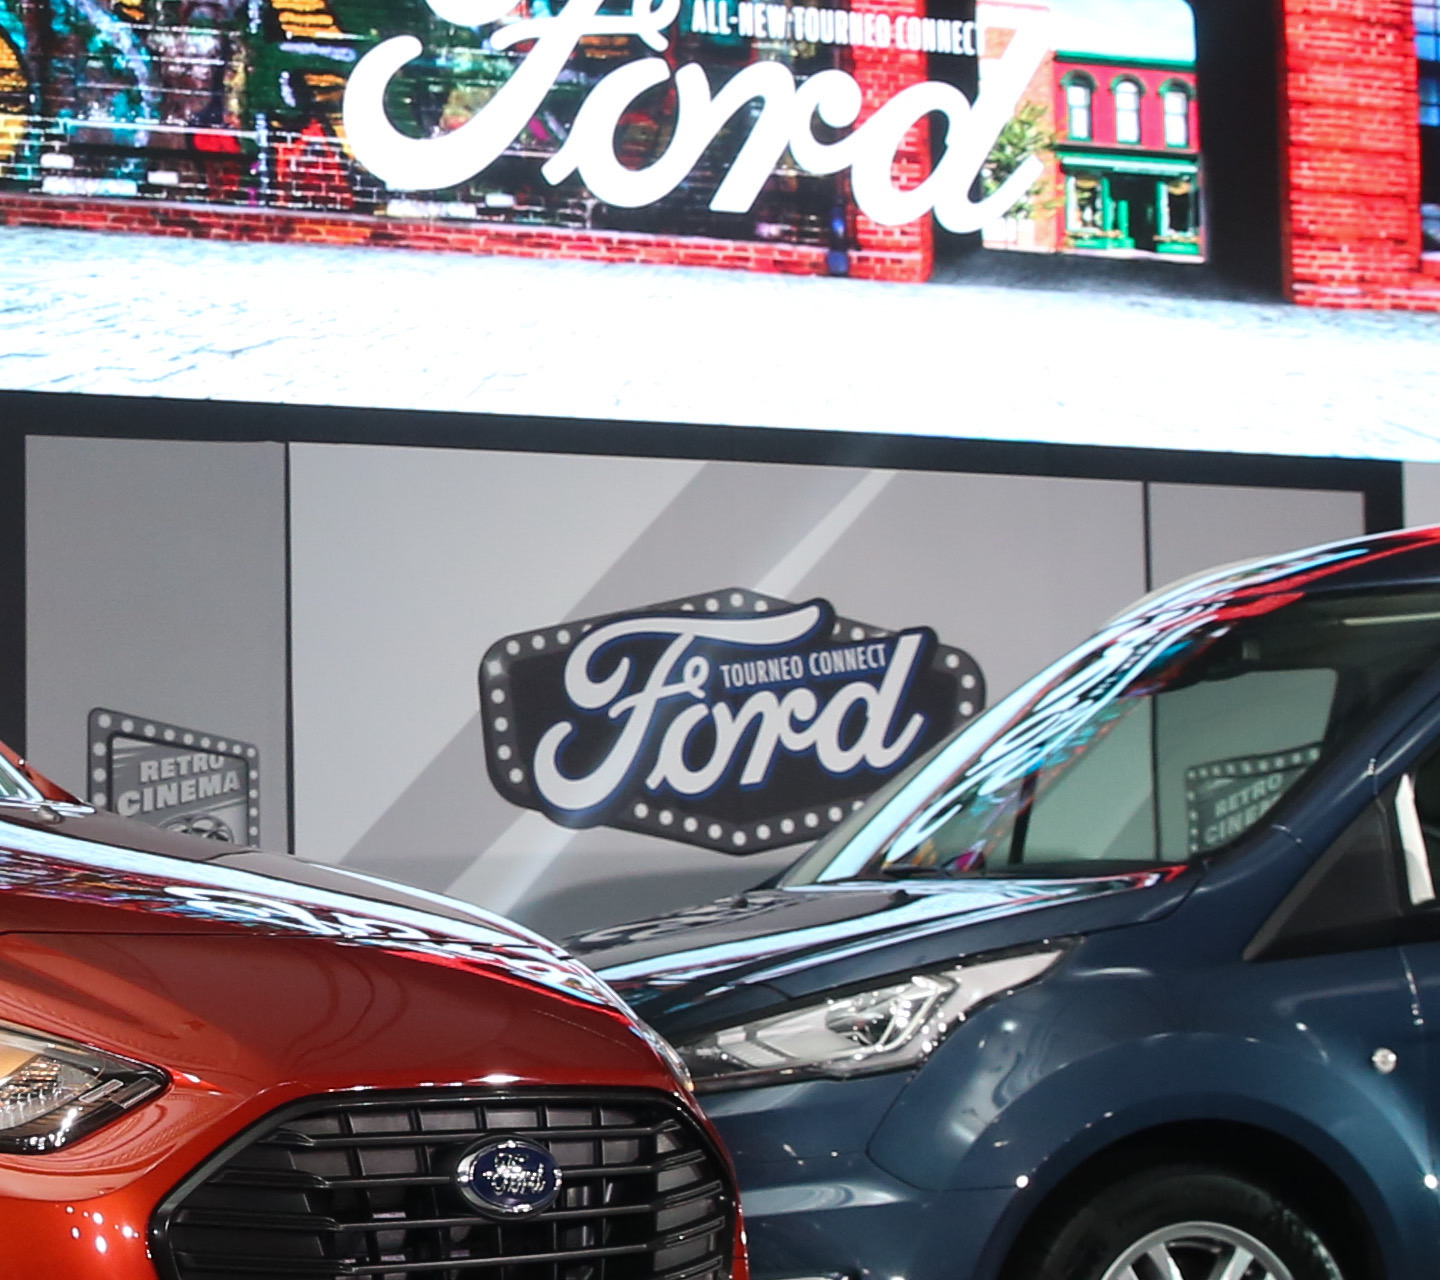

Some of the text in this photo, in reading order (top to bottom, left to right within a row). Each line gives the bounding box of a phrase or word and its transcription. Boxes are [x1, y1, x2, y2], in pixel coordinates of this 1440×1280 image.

[791, 6, 892, 49] TOURNEO
[720, 644, 887, 688] TOURNEO CONNECT
[533, 604, 925, 811] Ford
[140, 753, 225, 782] RETRO
[117, 770, 241, 818] CINEMA
